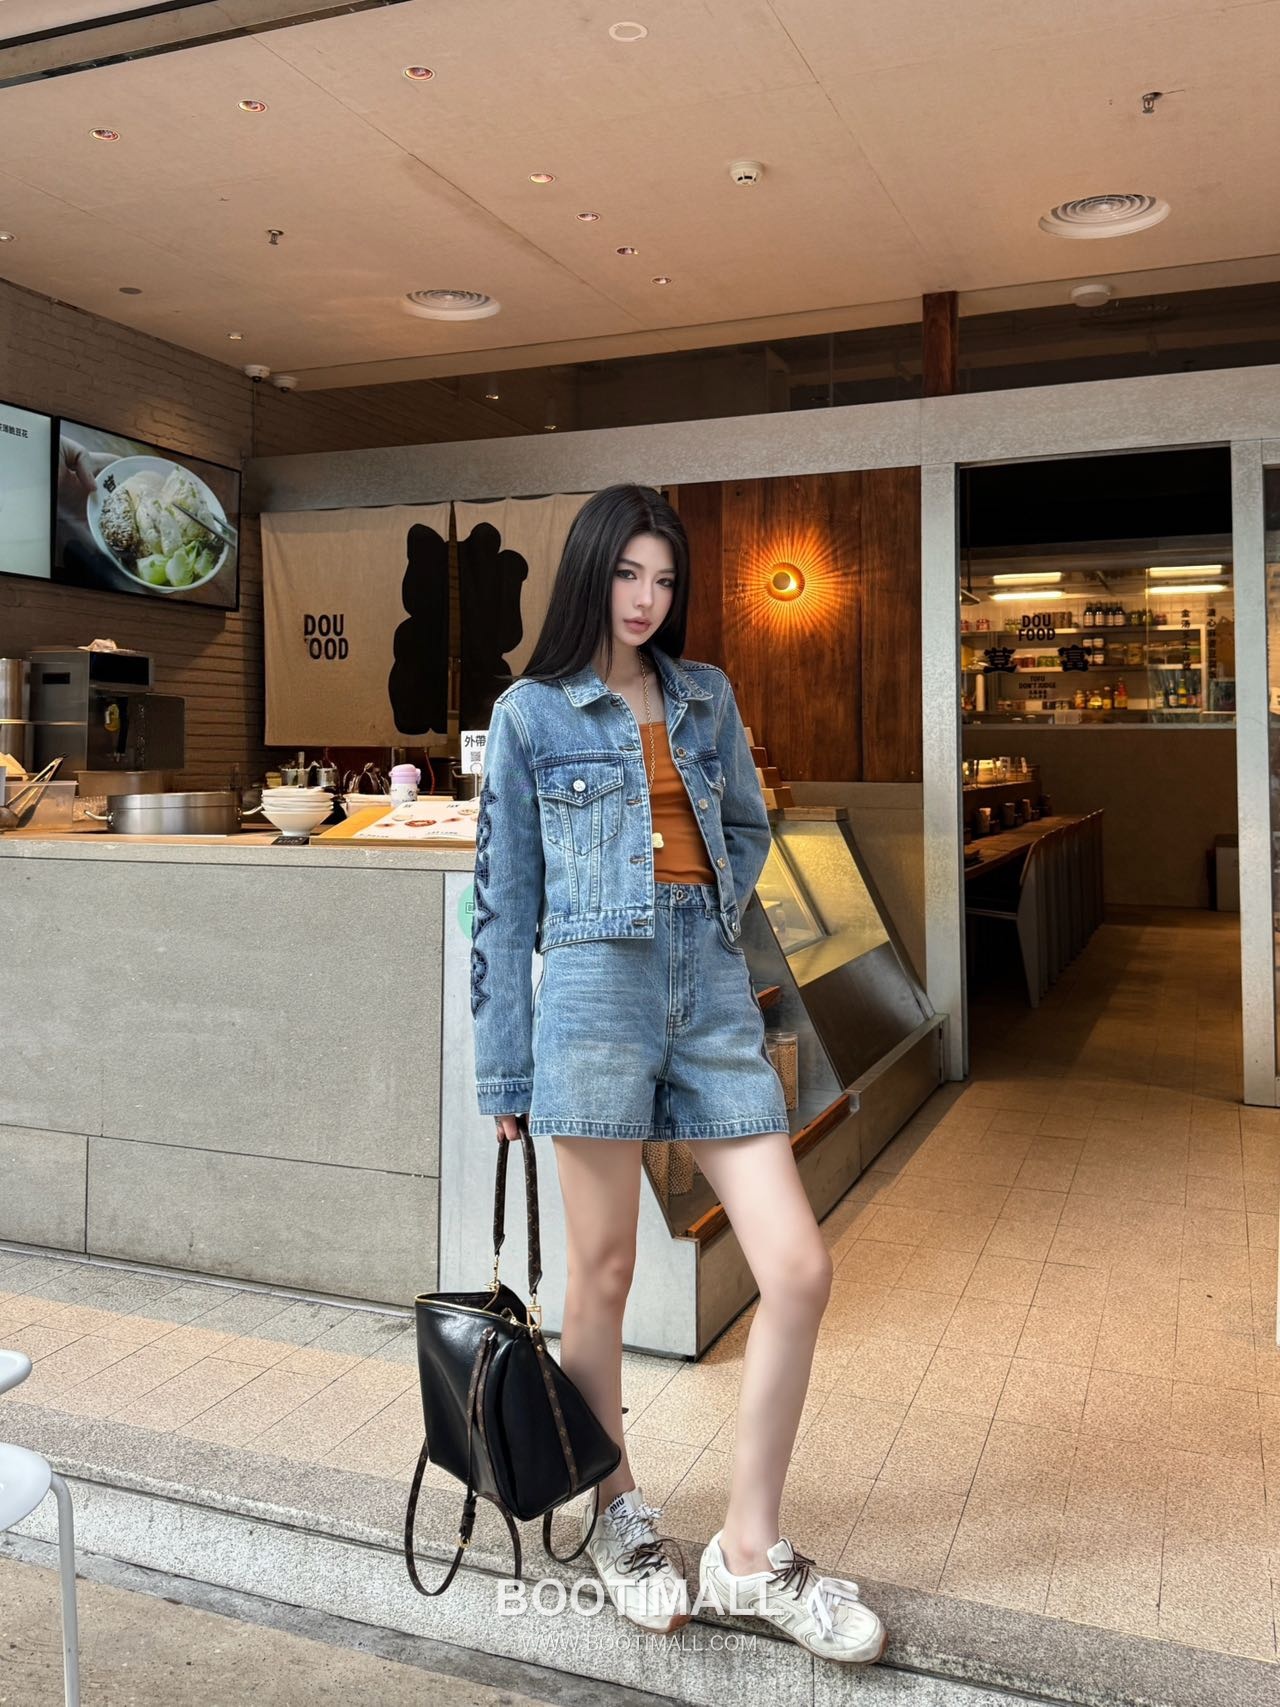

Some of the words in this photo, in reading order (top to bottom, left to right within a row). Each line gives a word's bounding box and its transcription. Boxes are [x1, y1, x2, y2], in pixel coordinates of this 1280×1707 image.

[304, 614, 344, 637] DOU
[1022, 614, 1051, 628] DOU
[1018, 628, 1056, 641] FOOD
[304, 637, 349, 660] OOD
[465, 735, 487, 748] 外帶
